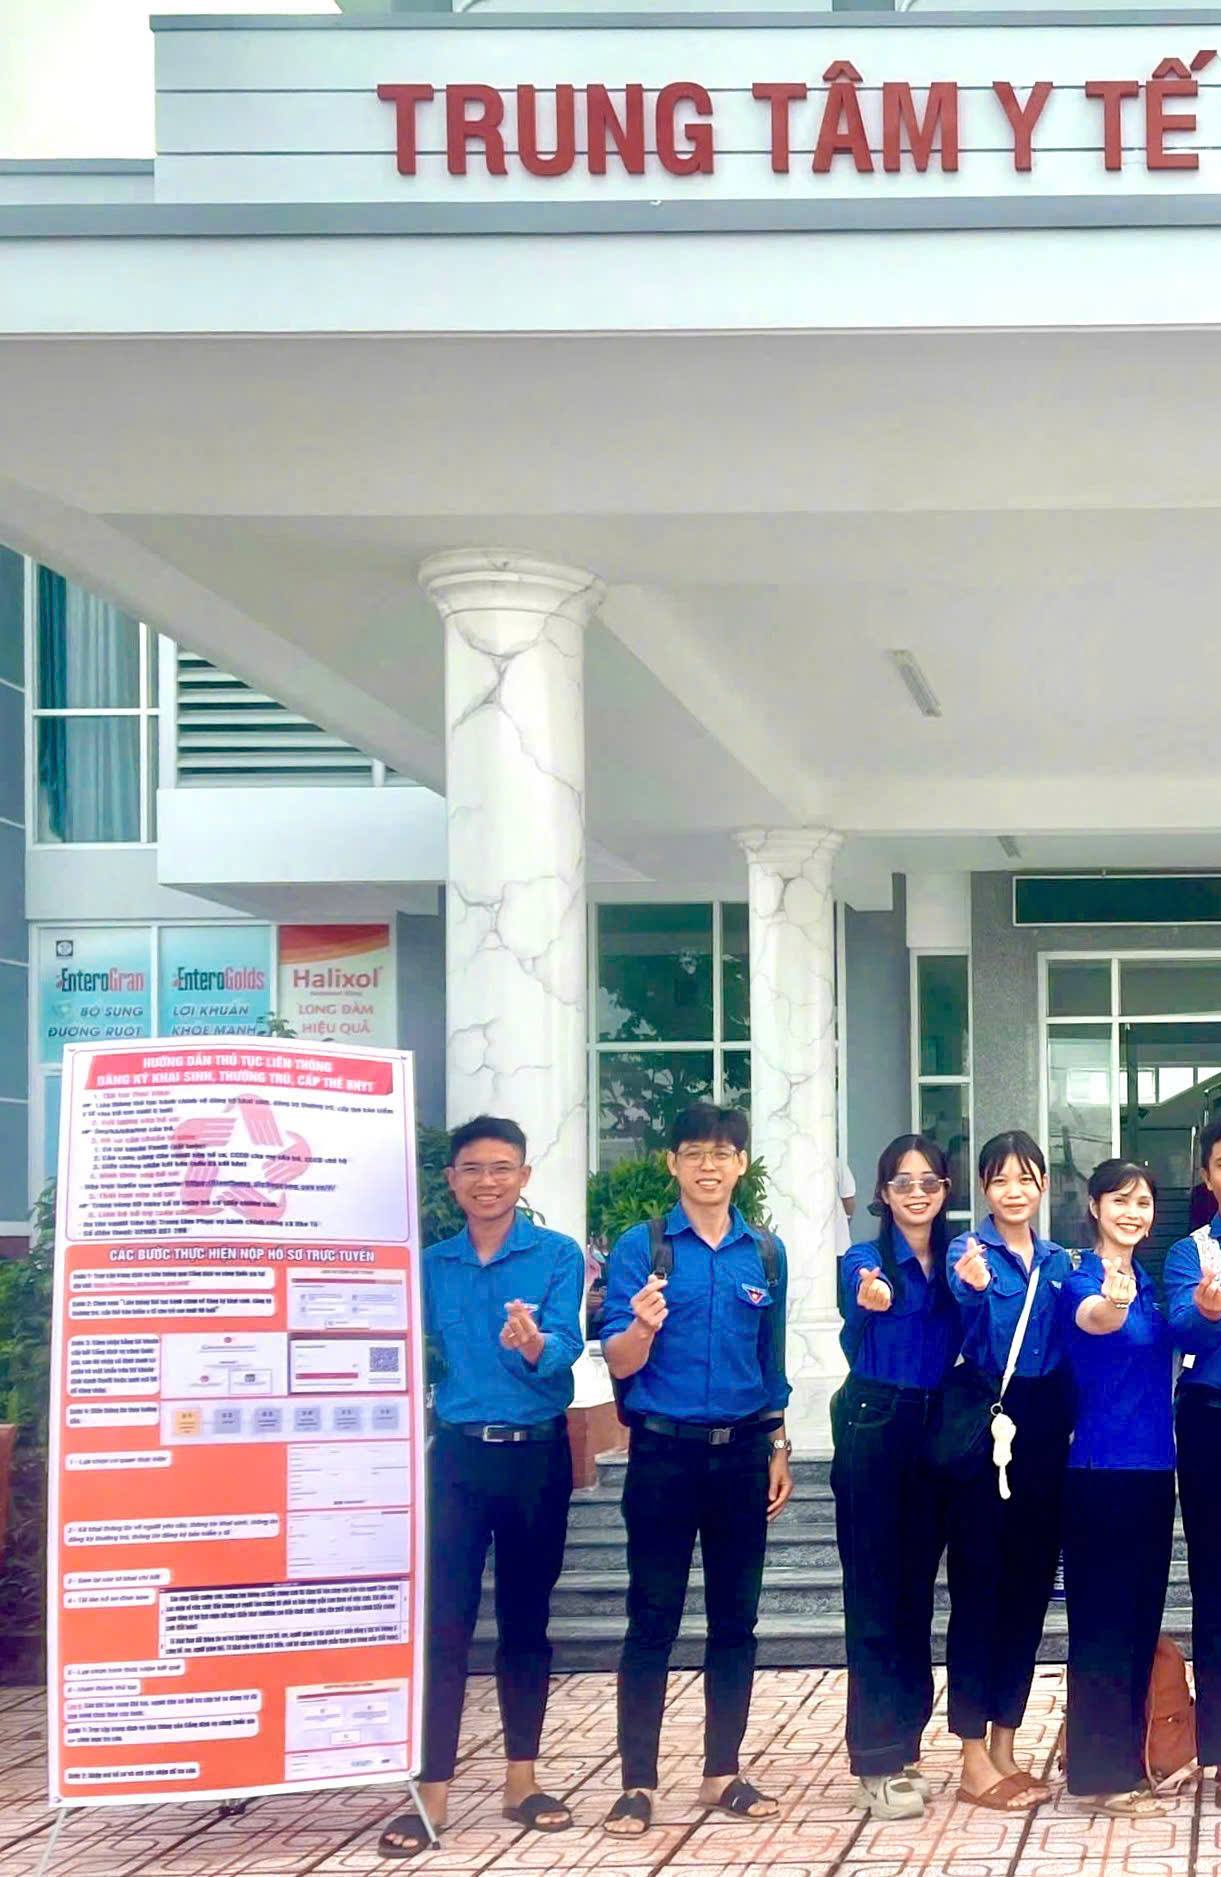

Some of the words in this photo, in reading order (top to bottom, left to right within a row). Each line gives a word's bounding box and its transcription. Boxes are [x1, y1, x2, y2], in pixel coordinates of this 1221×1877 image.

[378, 83, 714, 176] TRUNG
[752, 60, 959, 174] TÂM
[992, 81, 1054, 172] Y
[1085, 49, 1218, 171] TẾ
[293, 967, 379, 988] Halixol
[104, 1006, 144, 1017] SUNG
[109, 1247, 134, 1260] CÁC
[287, 1248, 303, 1260] SƠ
